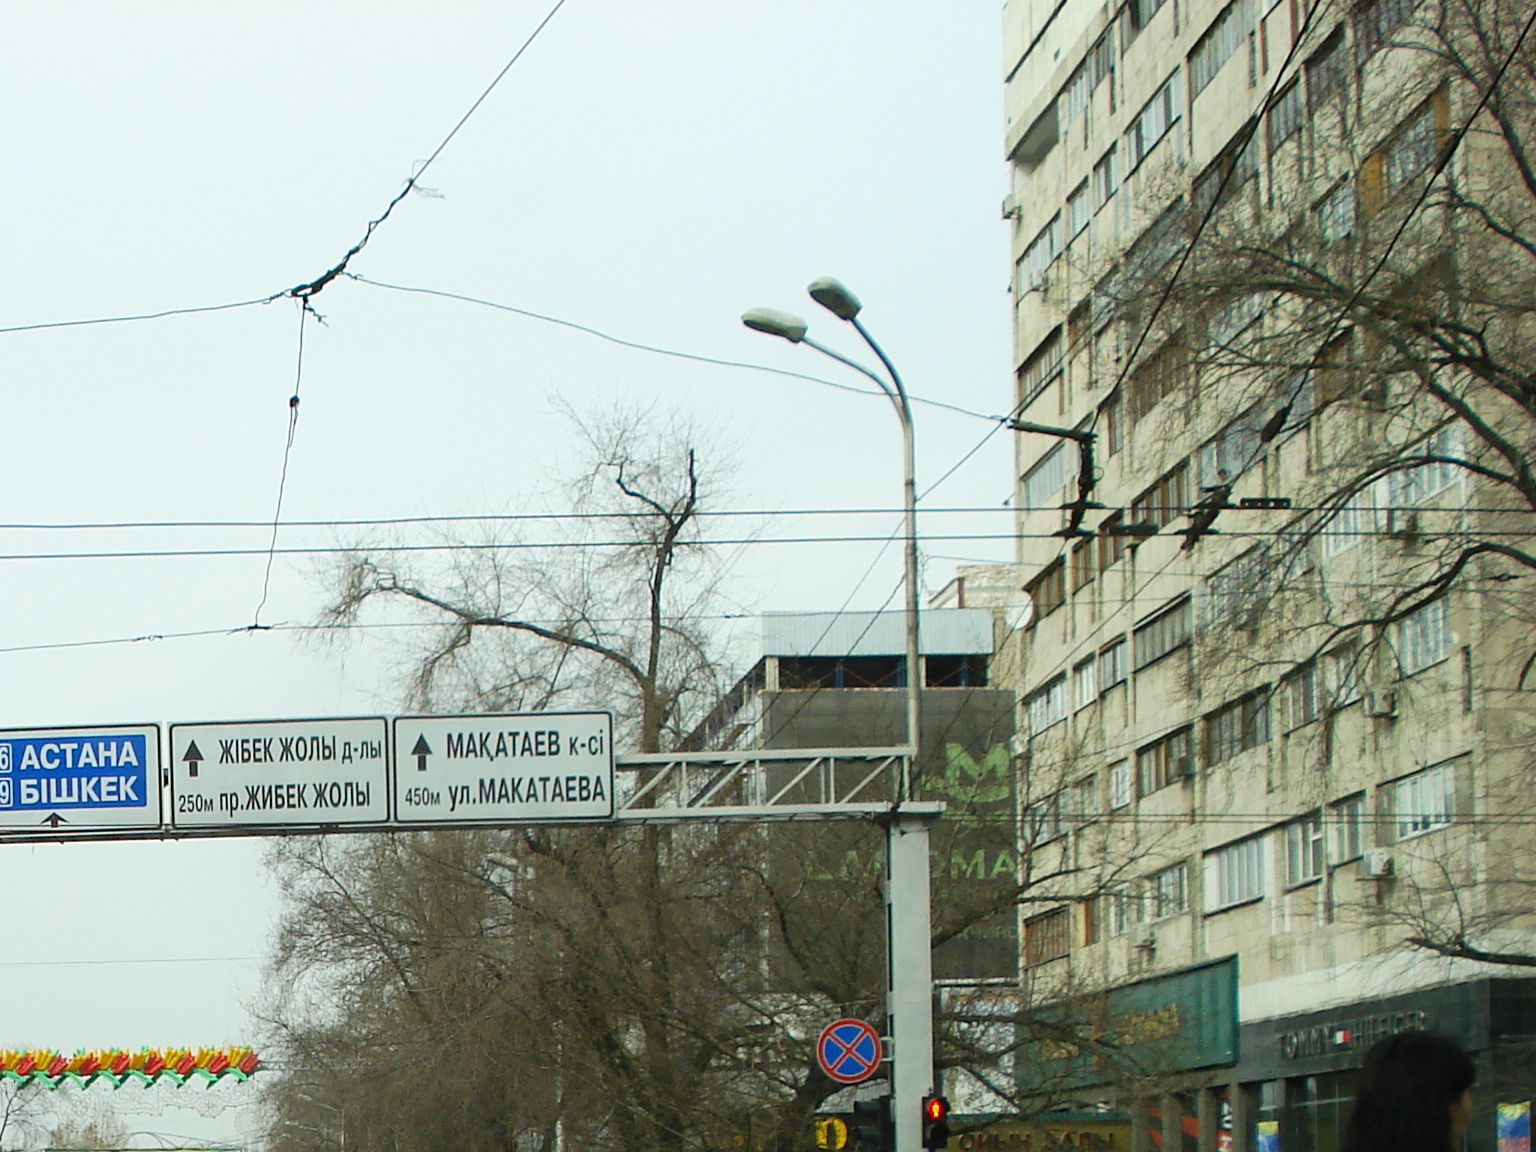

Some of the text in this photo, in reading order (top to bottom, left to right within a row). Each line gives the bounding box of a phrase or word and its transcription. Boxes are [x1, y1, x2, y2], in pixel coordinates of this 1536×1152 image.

[19, 741, 139, 770] АСТАНА
[218, 735, 382, 764] ЖІБЕК ЖОЛЫ д-лы
[446, 729, 604, 762] МАҚАТАЕВ к-сі
[19, 775, 139, 805] БІШКЕК
[178, 781, 371, 818] 250м пр.ЖИБЕК ЖОЛЫ
[404, 775, 606, 812] 450м ул.МАКАТАЕВА
